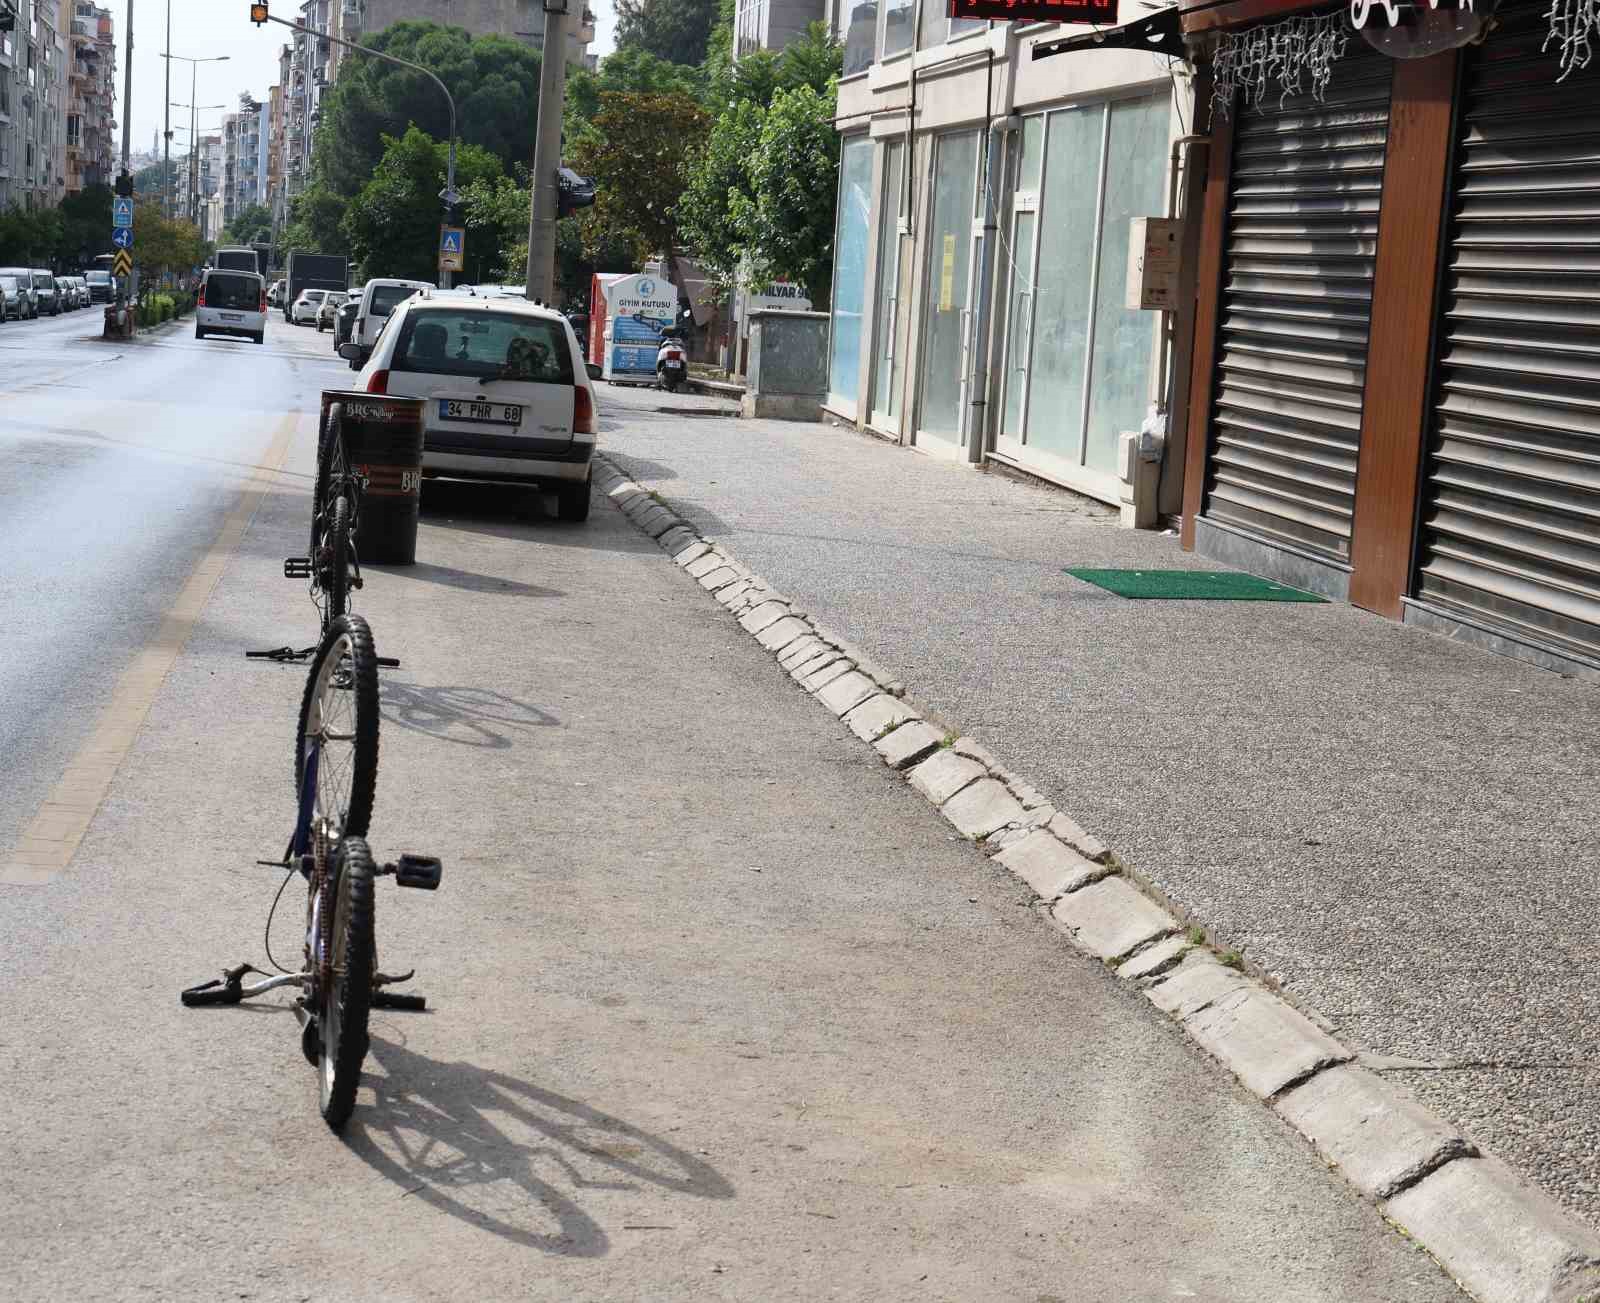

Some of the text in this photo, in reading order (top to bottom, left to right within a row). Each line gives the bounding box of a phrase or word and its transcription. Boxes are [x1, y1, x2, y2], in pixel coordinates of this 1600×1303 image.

[642, 300, 671, 308] KUTUSU
[448, 402, 462, 416] 34
[470, 404, 492, 418] PHR
